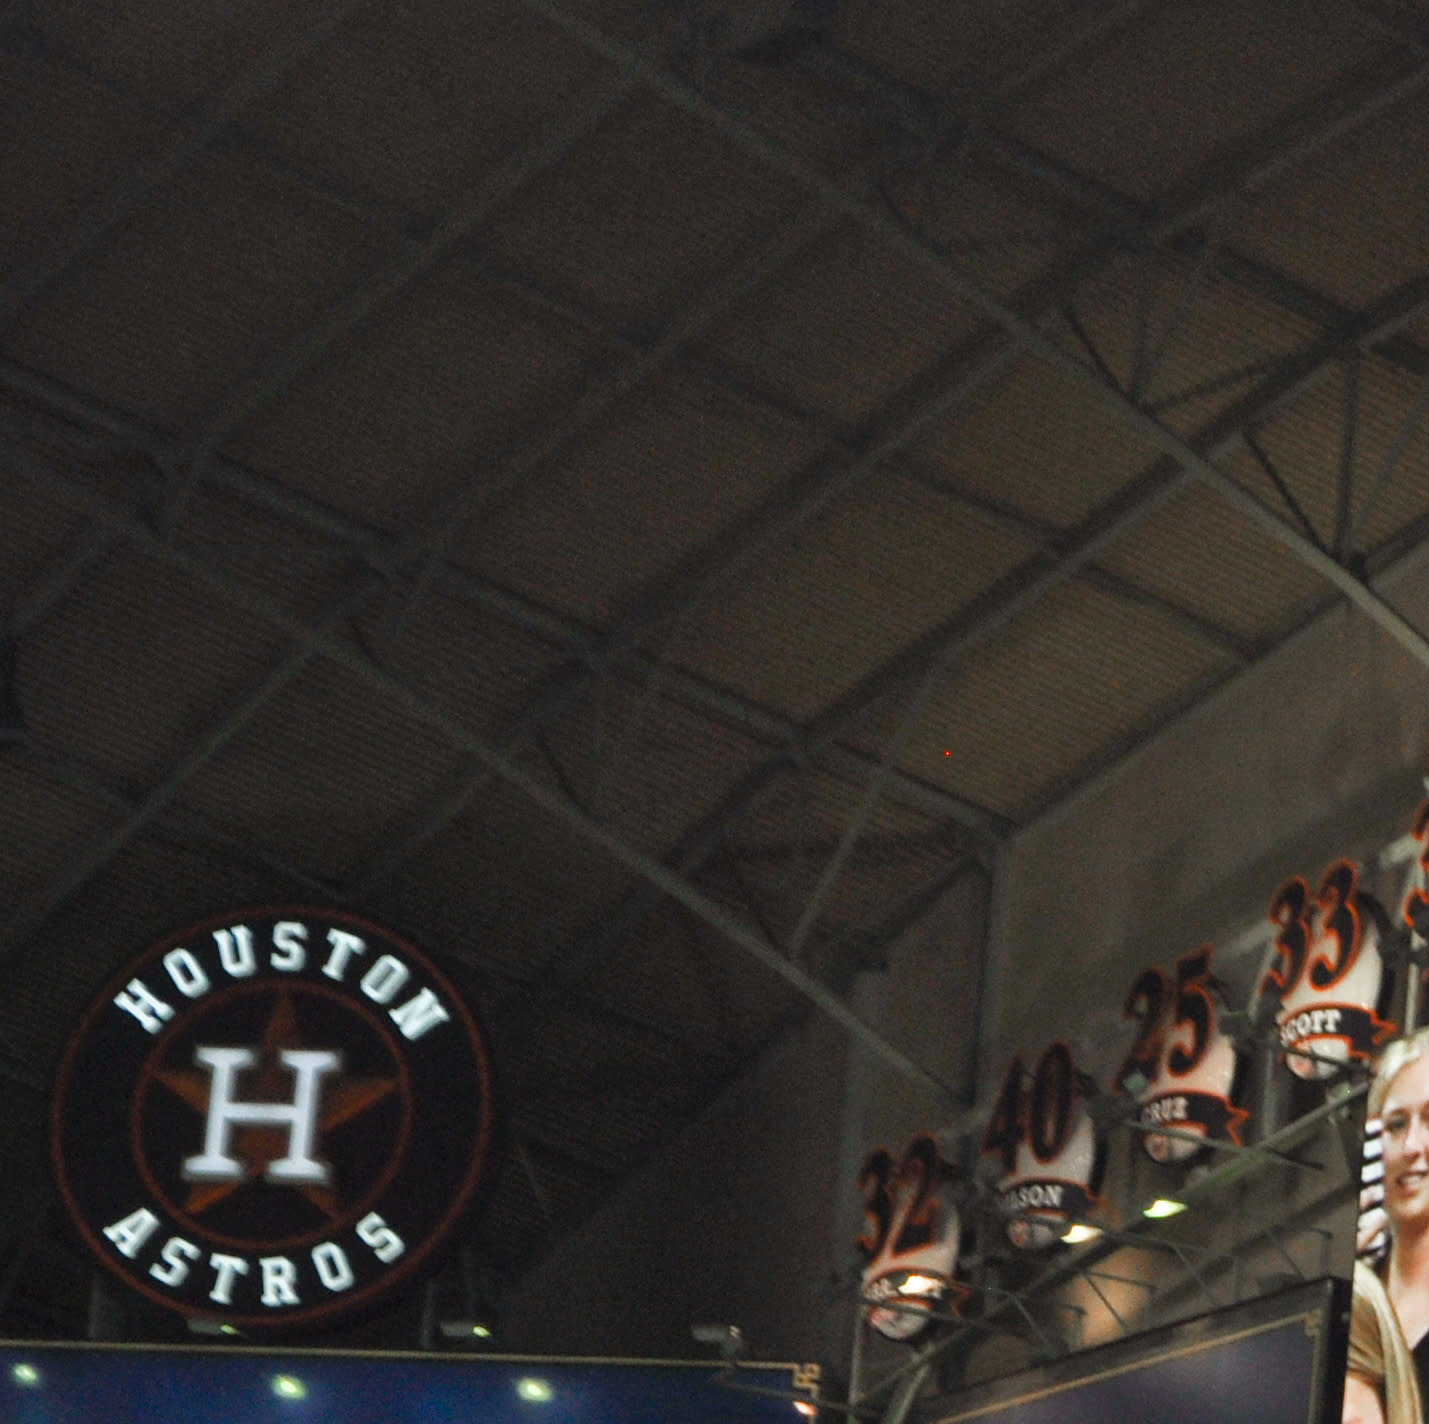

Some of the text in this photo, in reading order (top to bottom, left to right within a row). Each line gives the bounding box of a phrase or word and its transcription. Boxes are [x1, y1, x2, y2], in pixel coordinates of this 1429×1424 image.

[113, 919, 450, 1042] HOUSTON
[1259, 858, 1363, 1001] 33
[1112, 944, 1216, 1094] 25
[1279, 1009, 1343, 1046] SCOTT
[181, 1045, 344, 1184] H
[981, 1040, 1075, 1178] 40
[103, 1206, 407, 1307] ASTROS
[855, 1132, 941, 1261] 32
